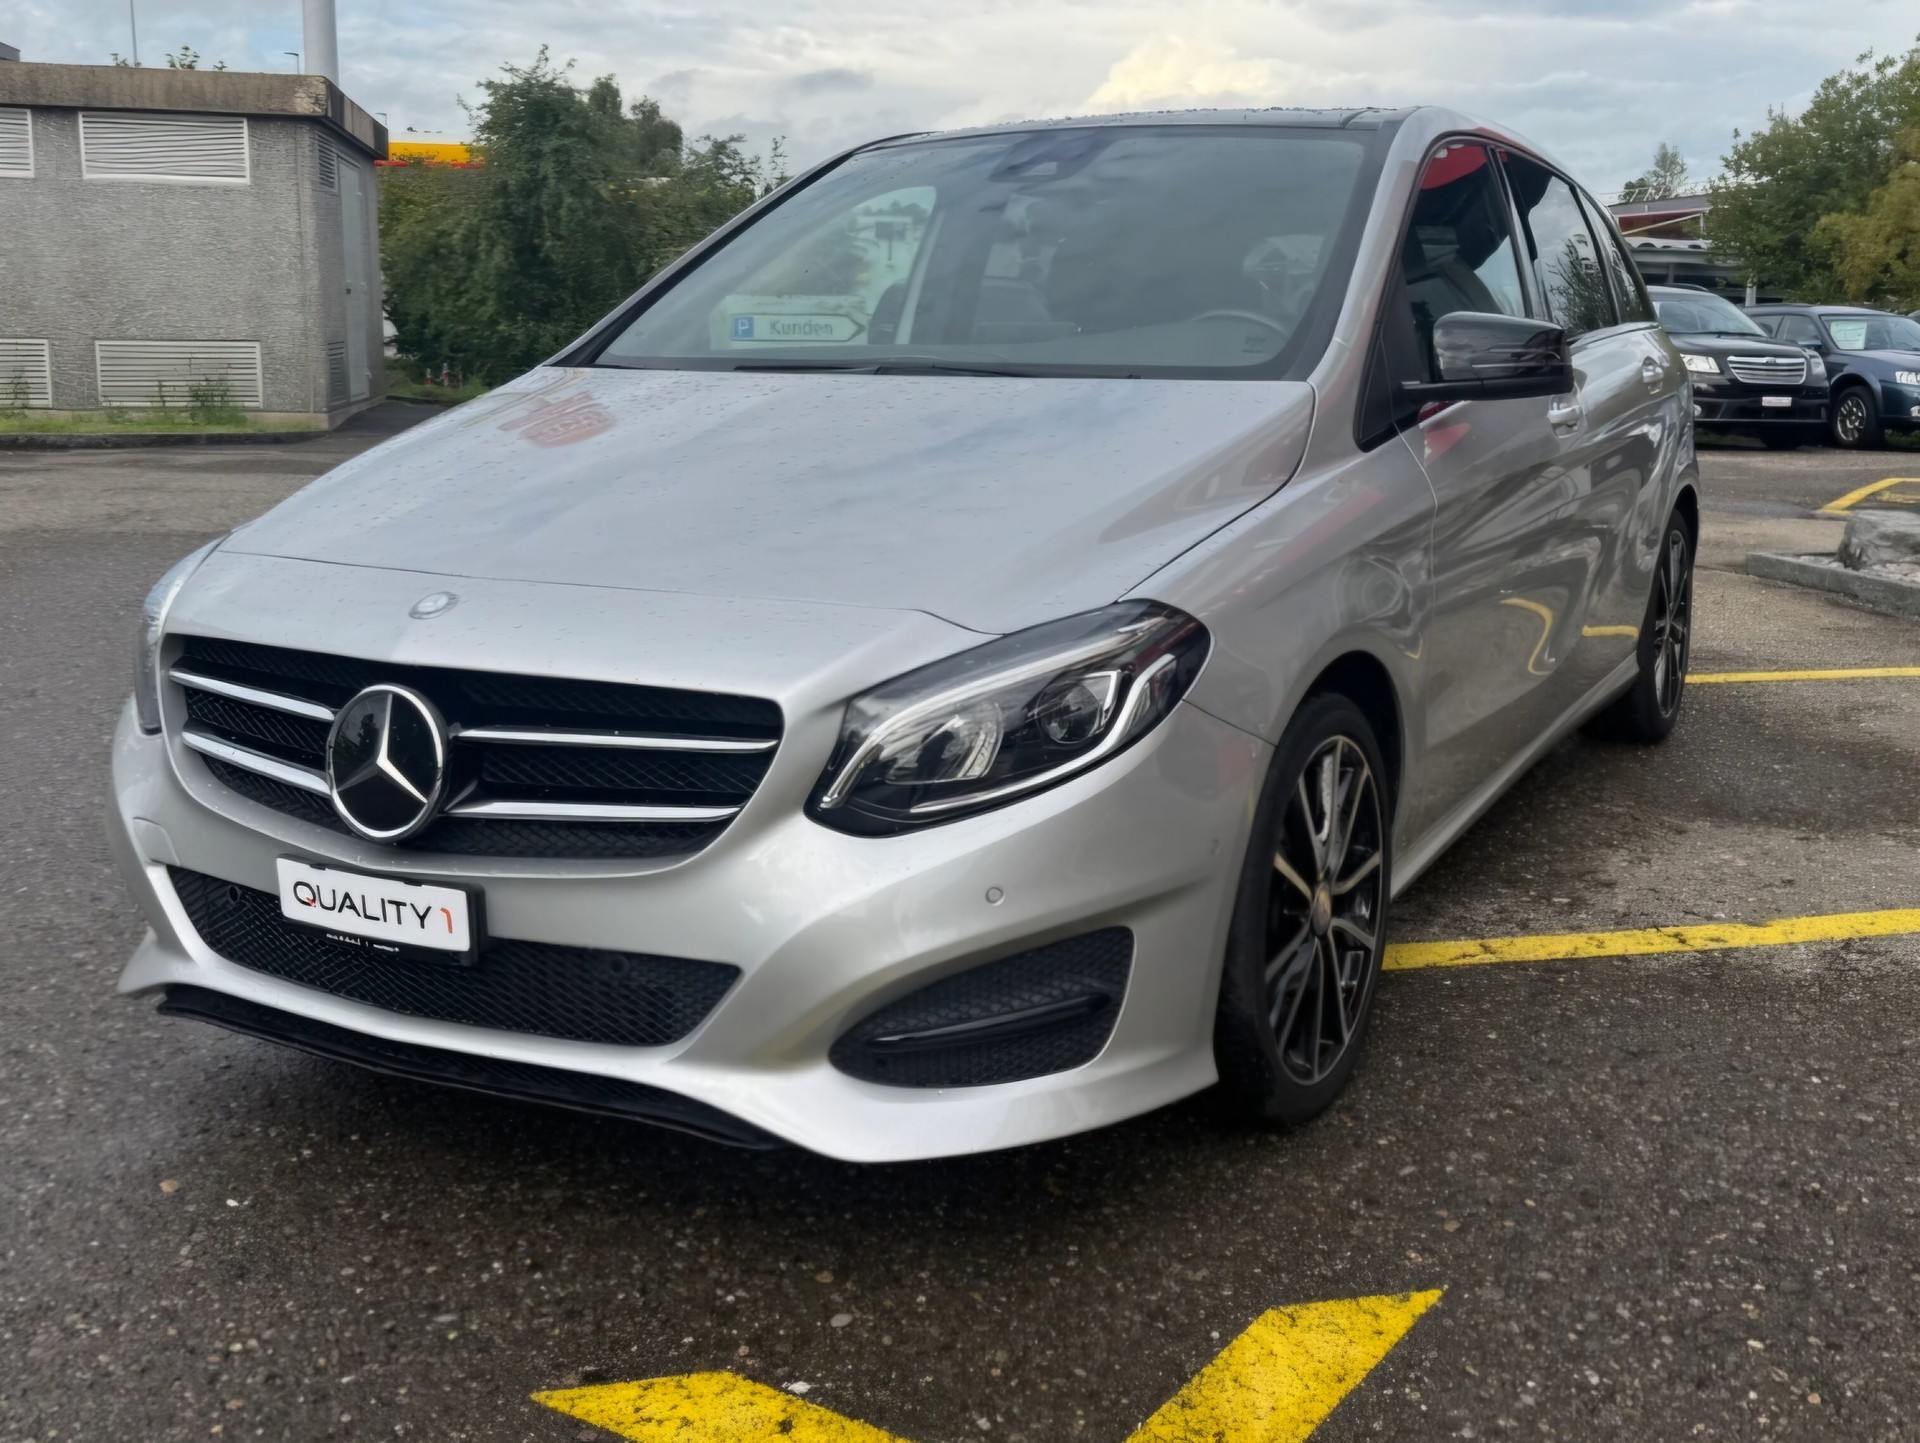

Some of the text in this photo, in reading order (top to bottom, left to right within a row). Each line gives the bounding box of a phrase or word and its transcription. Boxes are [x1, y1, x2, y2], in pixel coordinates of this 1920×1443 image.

[738, 318, 833, 336] P Kunden
[293, 881, 453, 934] QUALITY 1
